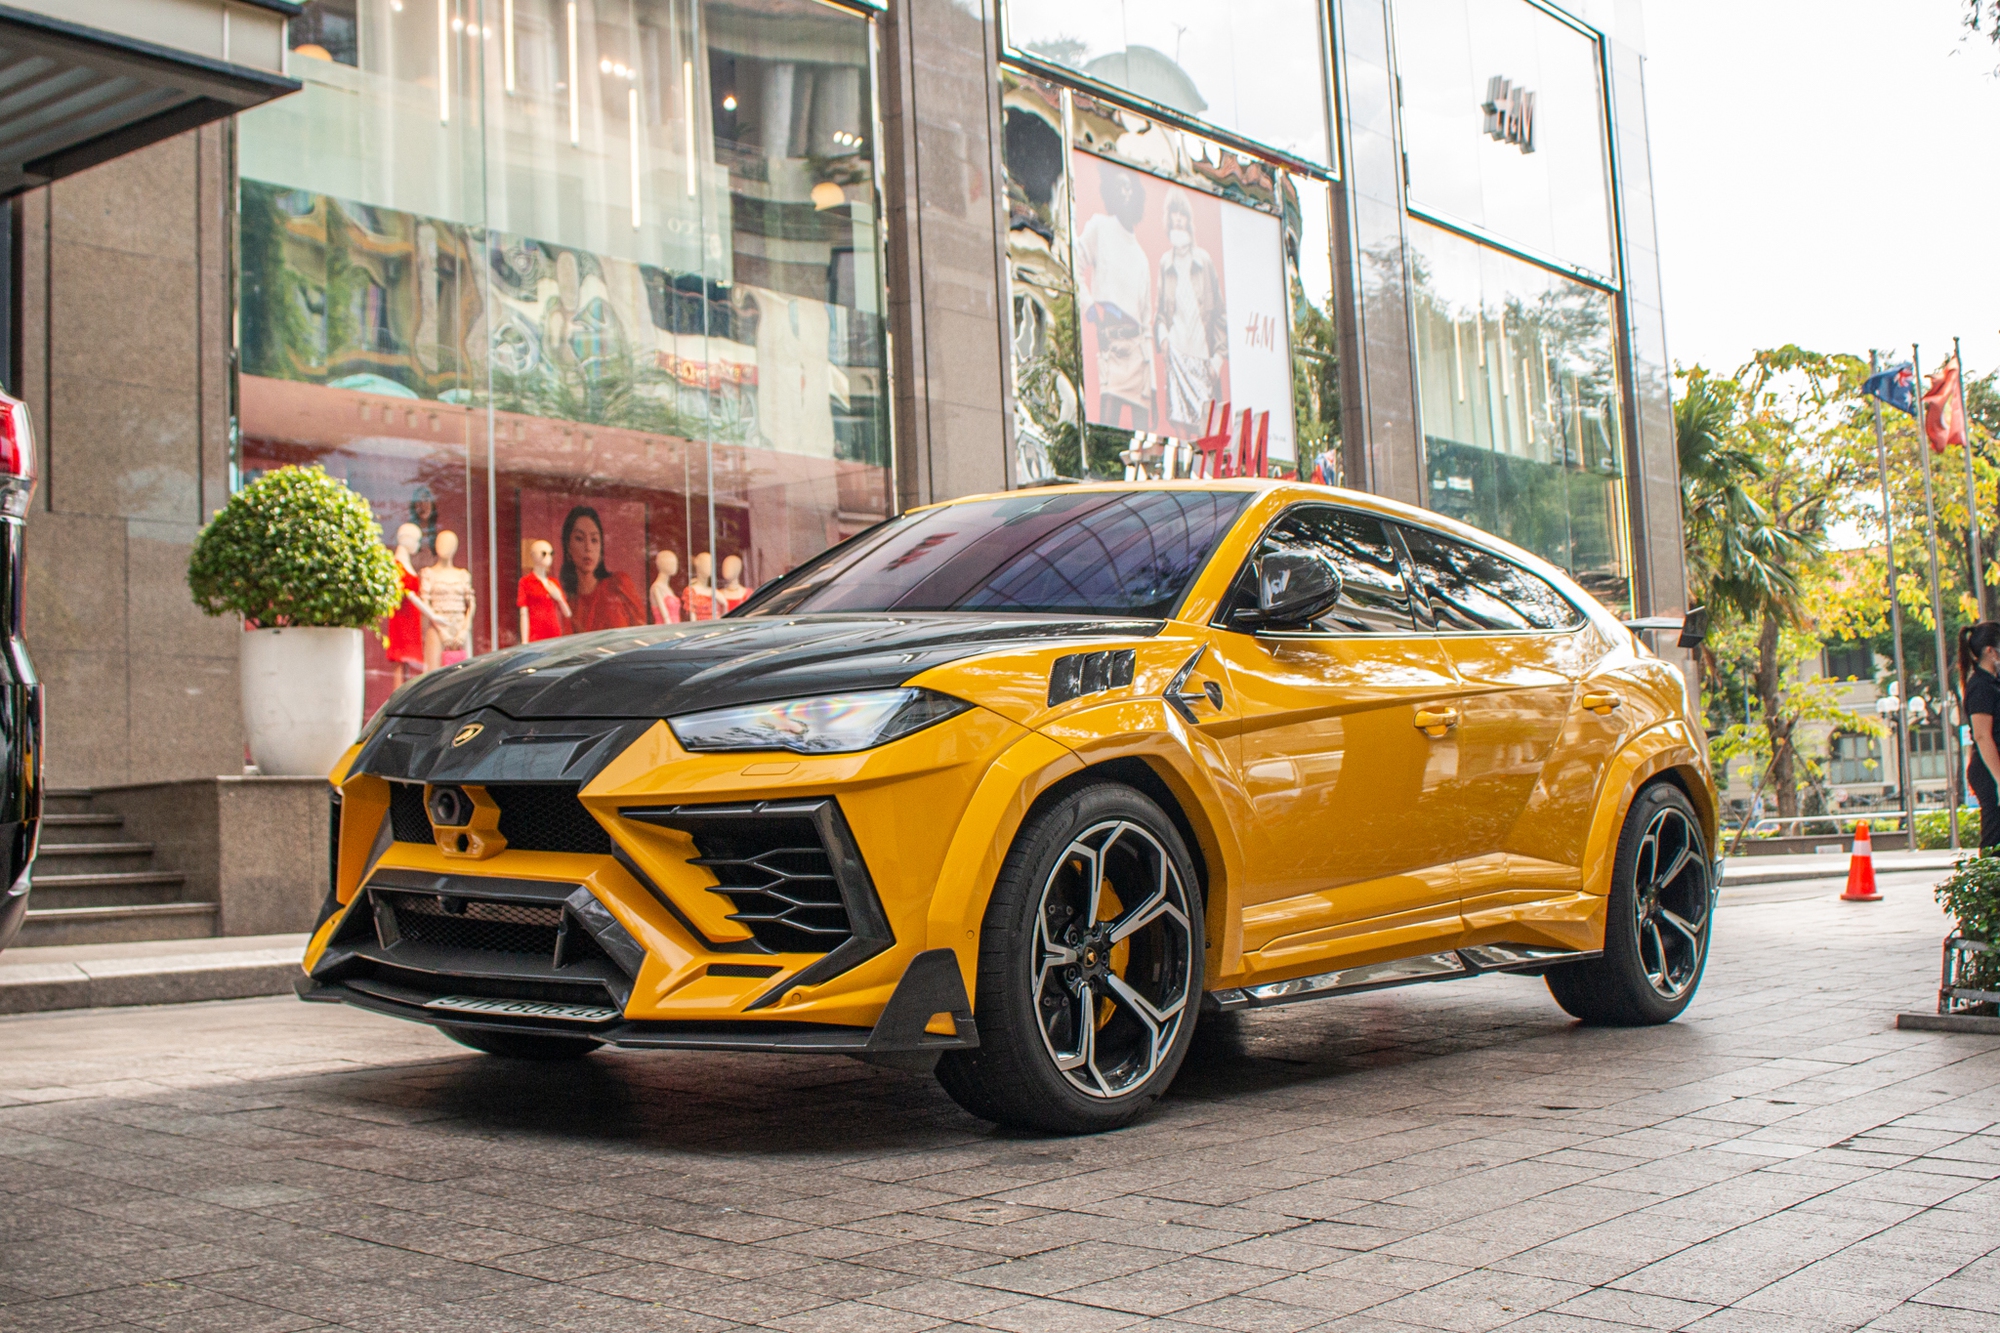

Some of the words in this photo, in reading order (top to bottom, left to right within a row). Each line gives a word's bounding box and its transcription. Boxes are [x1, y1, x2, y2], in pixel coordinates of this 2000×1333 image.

[1482, 75, 1535, 154] H&M
[1245, 310, 1275, 353] H&M
[1193, 399, 1269, 479] H&M
